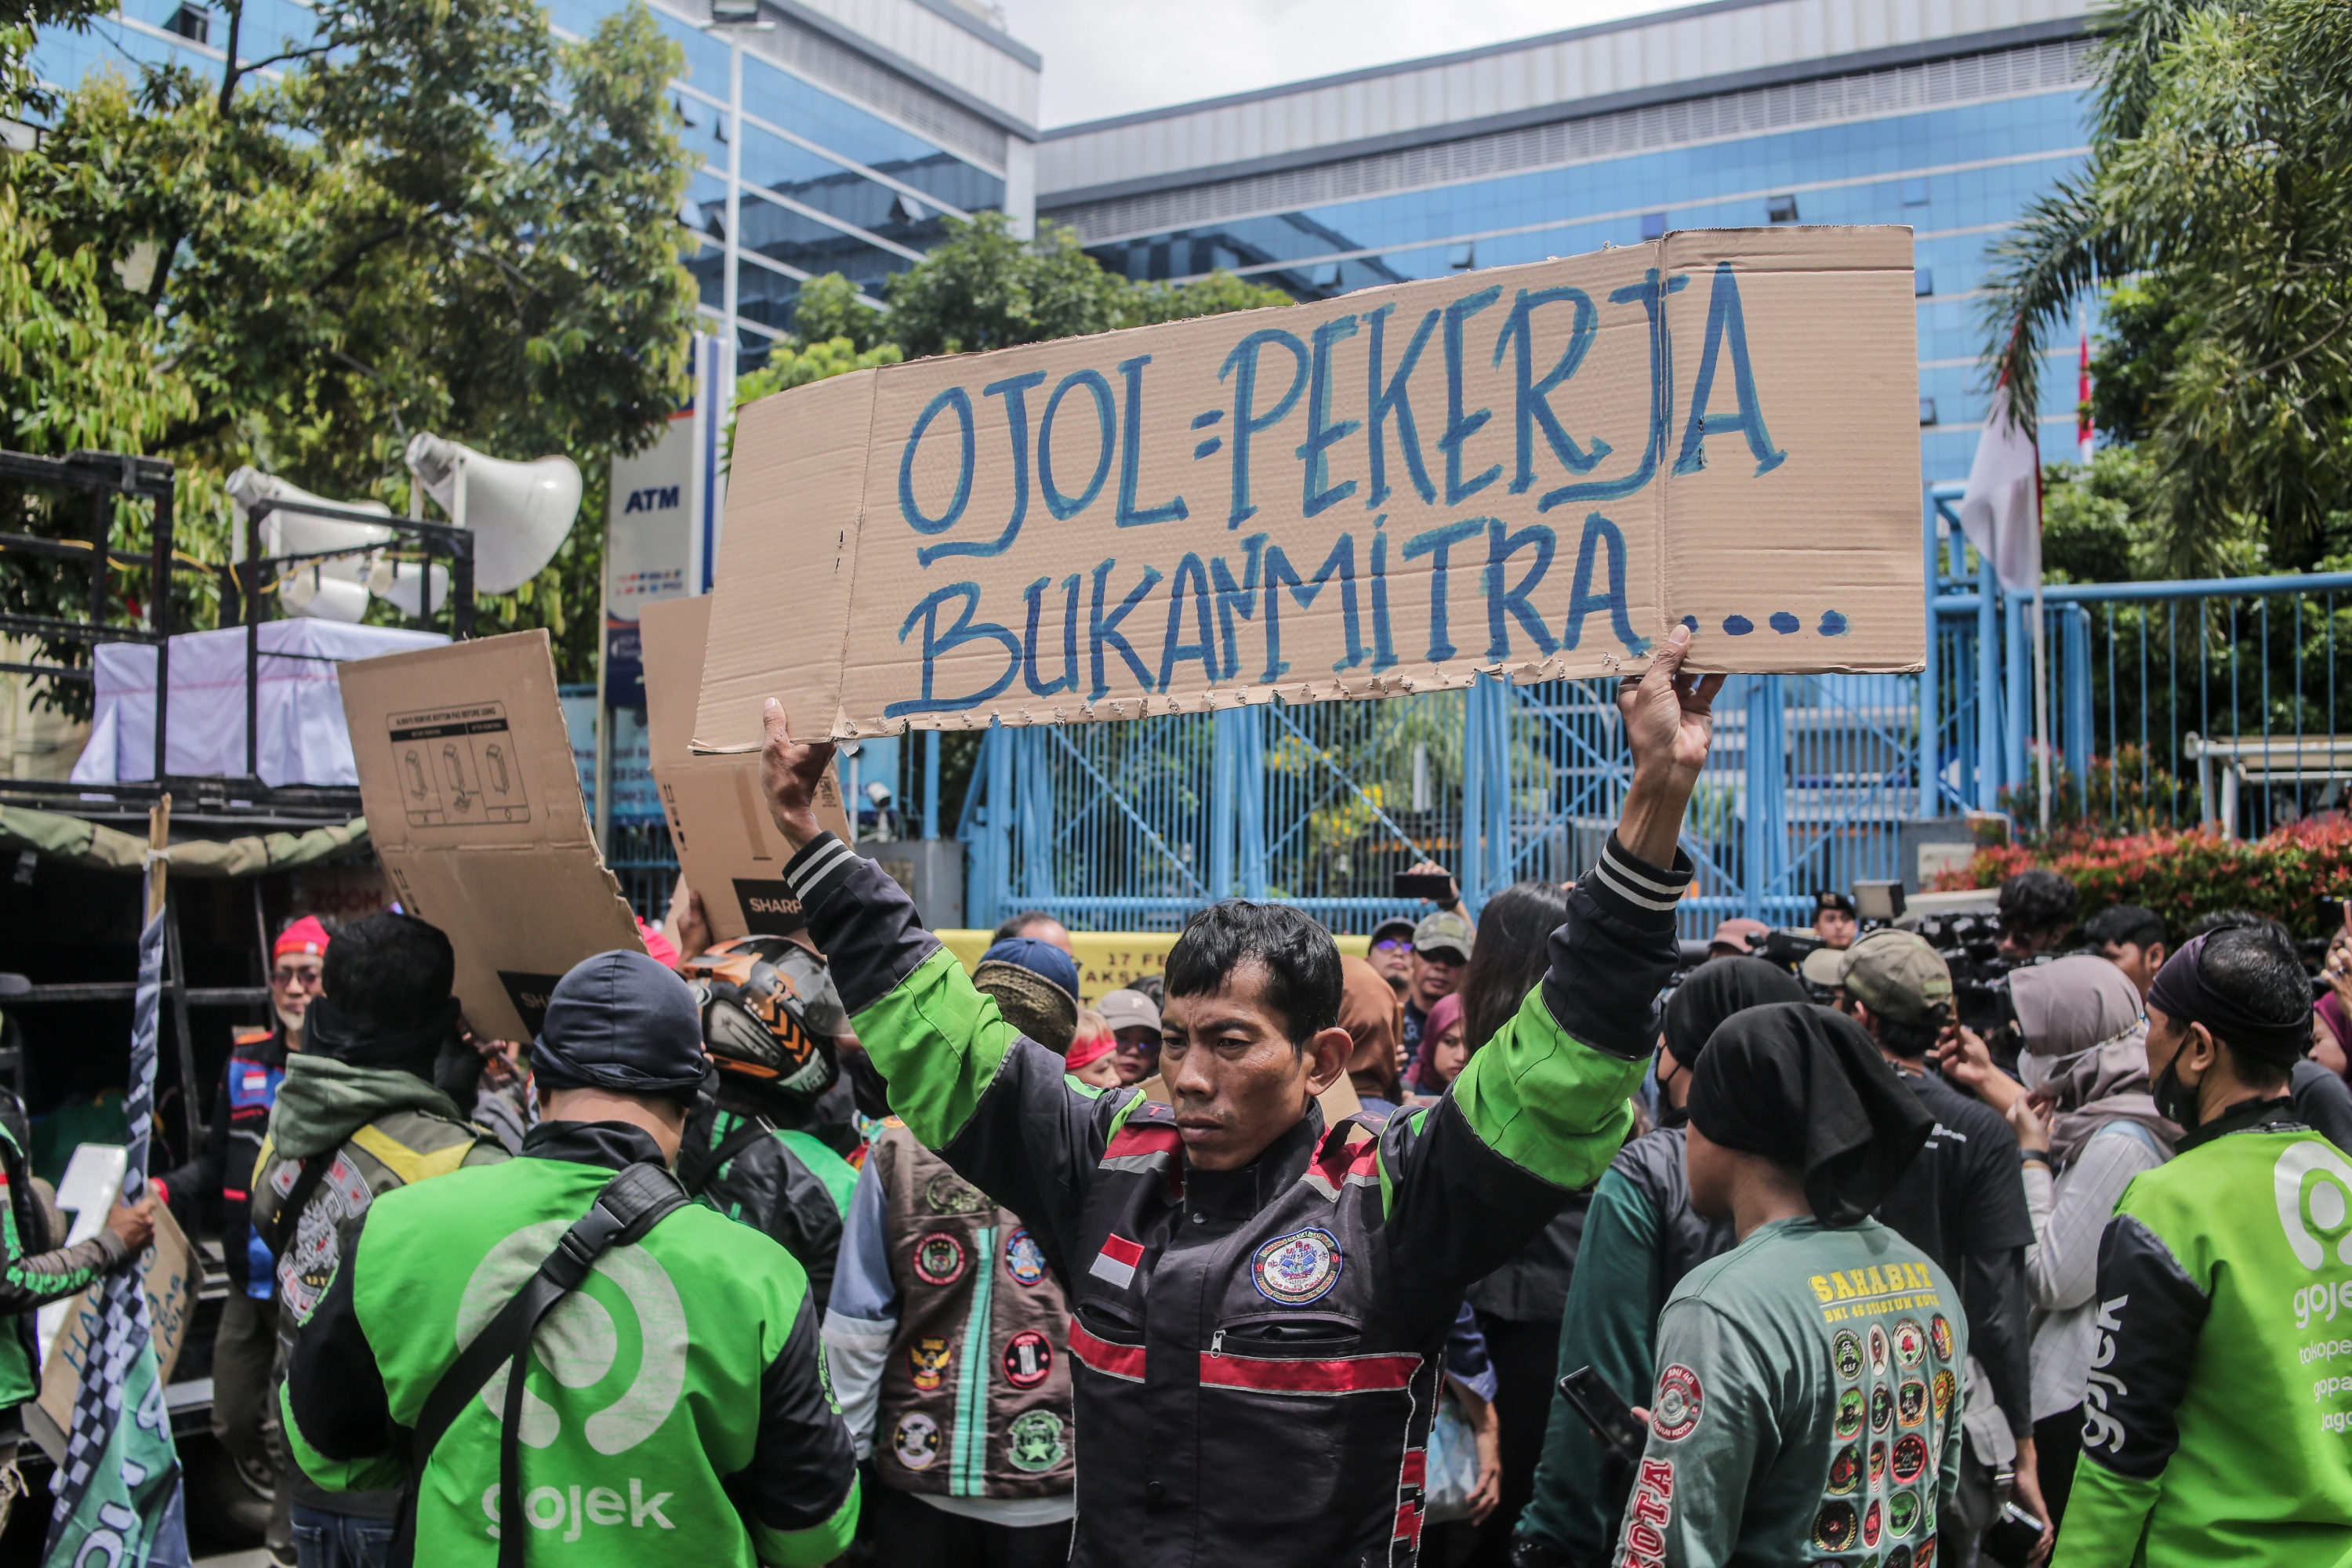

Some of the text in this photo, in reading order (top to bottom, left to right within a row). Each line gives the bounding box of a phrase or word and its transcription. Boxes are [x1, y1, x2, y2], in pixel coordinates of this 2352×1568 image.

[624, 486, 680, 514] ATM
[750, 898, 803, 915] SHARP
[1109, 953, 1131, 966] 17
[1808, 1263, 1933, 1303] SAHABAT
[1824, 1306, 1849, 1323] BNI
[1852, 1304, 1865, 1317] 46
[1915, 1294, 1940, 1308] KOTA
[1667, 1367, 1683, 1377] BNI
